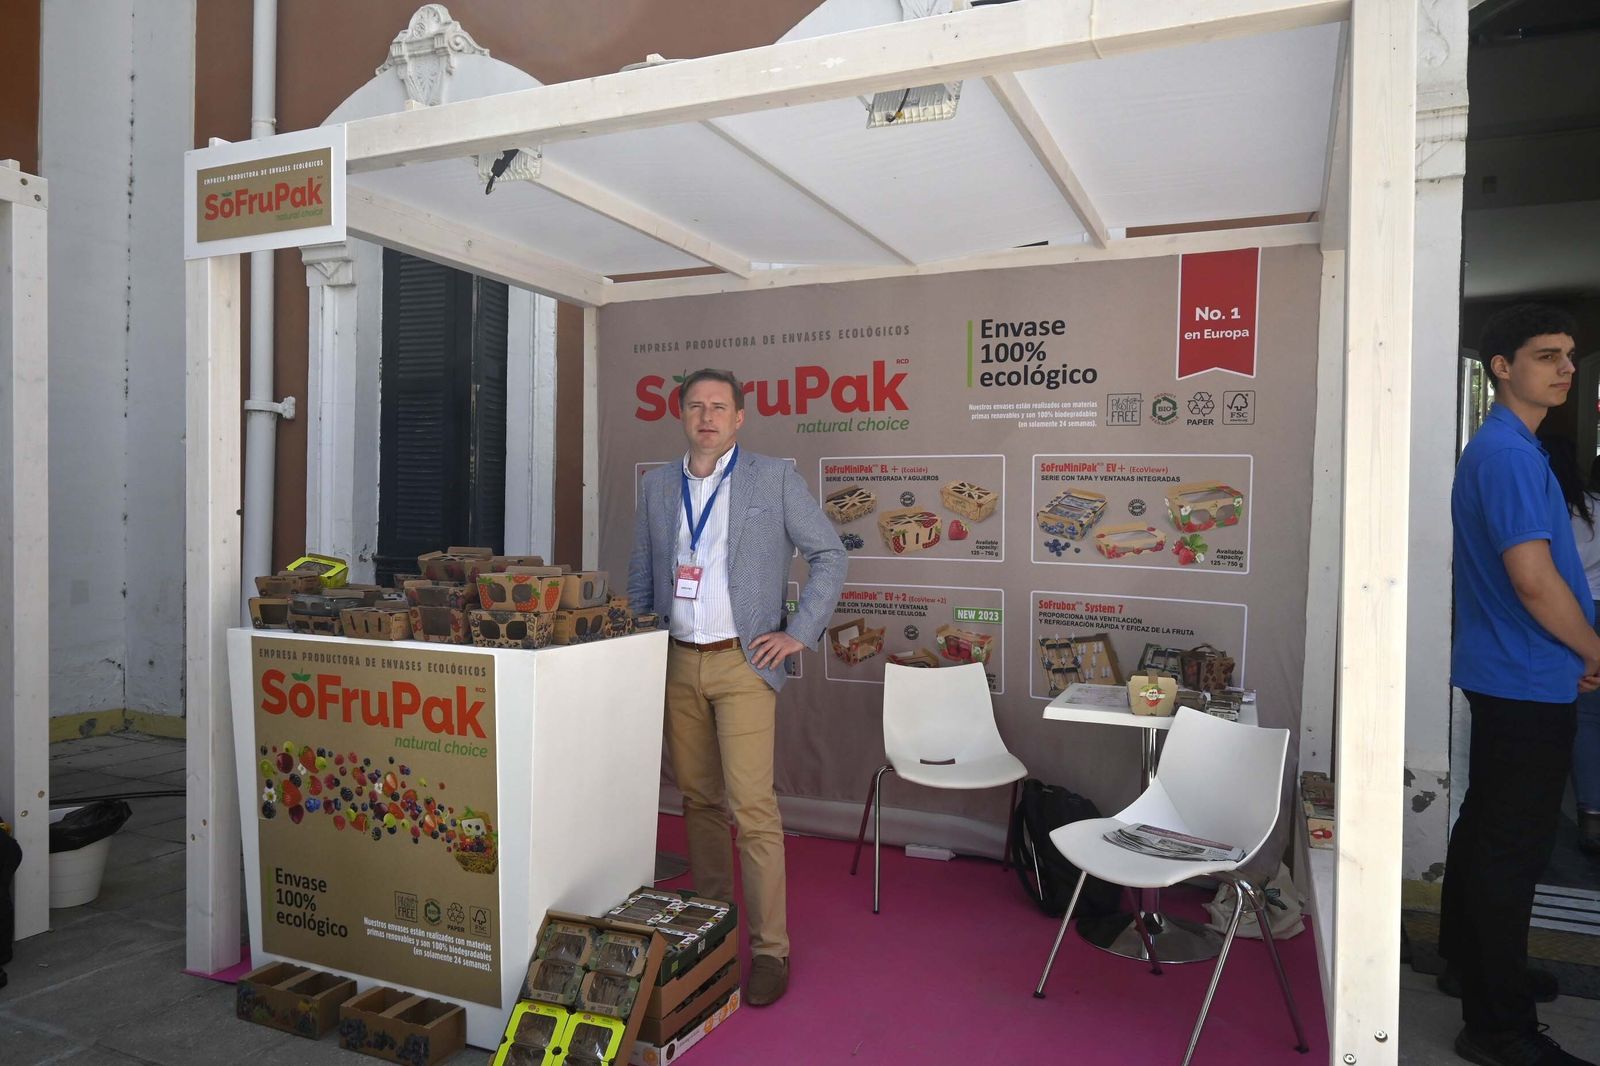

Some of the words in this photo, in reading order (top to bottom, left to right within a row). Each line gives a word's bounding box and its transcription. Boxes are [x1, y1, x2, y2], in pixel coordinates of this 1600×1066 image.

[227, 171, 259, 181] PRODUCTORA
[269, 165, 291, 175] ENVASES
[1195, 306, 1226, 321] No.
[1230, 307, 1241, 319] 1
[980, 319, 1066, 339] Envase
[1184, 330, 1200, 341] en
[1203, 328, 1250, 341] Europa
[633, 341, 680, 353] EMPRESA
[685, 336, 756, 350] PRODUCTORA
[762, 335, 776, 346] DE
[782, 330, 831, 343] ENVASES
[838, 324, 910, 340] ECOLÓGICOS
[980, 341, 1047, 364] 100%
[980, 363, 1098, 390] ecológico
[635, 360, 909, 422] SruPak
[969, 403, 992, 411] Nuestros
[971, 412, 989, 420] primas
[1054, 410, 1097, 418] biodegradables
[1111, 410, 1138, 423] FREE
[1186, 418, 1214, 426] PAPER
[796, 418, 853, 434] natural
[857, 416, 910, 432] choice
[880, 464, 888, 473] EL
[1040, 463, 1097, 473] SoFruMiniPak
[841, 592, 877, 600] ruMiniPak
[786, 602, 795, 612] 23
[957, 609, 976, 619] NEW
[978, 610, 999, 621] 2023
[1039, 600, 1076, 611] SoFrubox
[1084, 603, 1115, 614] System
[1118, 604, 1124, 614] 7
[1038, 611, 1084, 620] PROPORCIONA
[1100, 615, 1143, 624] VENTILACIÓN
[1044, 619, 1094, 628] REFRIGERACIÓN
[1095, 621, 1120, 630] RÁPIDA
[1126, 624, 1150, 633] EFICAZ
[1151, 626, 1160, 634] DE
[1172, 628, 1195, 636] FRUTA
[259, 648, 298, 661] EMPRESA
[302, 653, 361, 667] PRODUCTORA
[365, 658, 377, 668] DE
[381, 658, 422, 672] ENVASES
[428, 662, 487, 678] ECOLÓGICOS
[261, 668, 487, 739] SoFruPak
[394, 736, 441, 753] natural
[444, 741, 488, 759] choice
[275, 867, 328, 894] Envase
[276, 888, 317, 912] 100%
[397, 906, 416, 919] FREE
[276, 909, 349, 938] ecológico
[447, 924, 465, 933] PAPER
[363, 916, 387, 929] Nuestros
[387, 922, 409, 934] envases
[410, 927, 426, 937] están
[426, 929, 454, 943] realizados
[455, 937, 466, 946] con
[466, 938, 492, 952] materias
[366, 928, 385, 938] primas
[385, 932, 415, 945] renovables
[415, 938, 420, 946] y
[420, 940, 431, 948] son
[432, 941, 449, 952] 100%
[449, 944, 492, 962] biodegradables
[413, 947, 423, 956] (en
[423, 950, 453, 963] solamente
[454, 956, 462, 964] 24
[462, 959, 493, 972] semanas).
